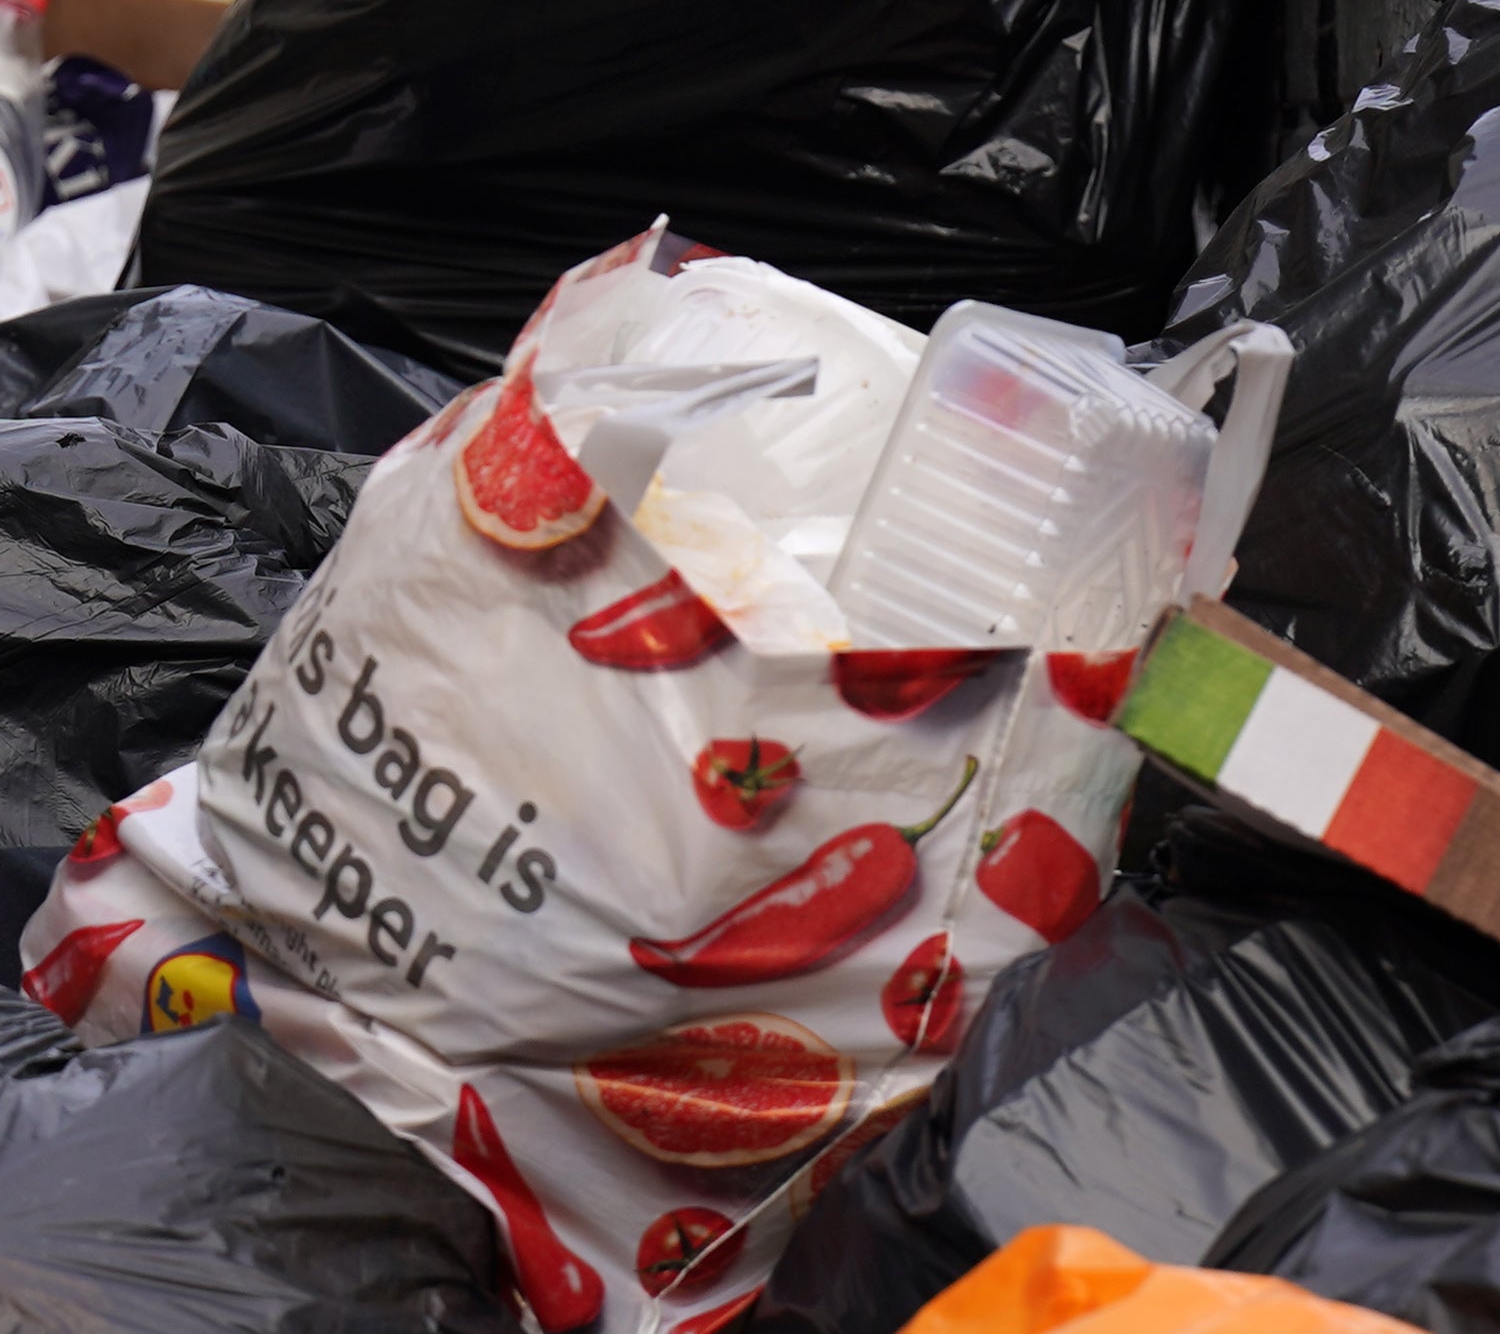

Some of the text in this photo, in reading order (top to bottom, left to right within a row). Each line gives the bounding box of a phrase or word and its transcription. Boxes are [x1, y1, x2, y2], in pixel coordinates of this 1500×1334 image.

[242, 701, 457, 989] keeper
[337, 655, 477, 857] bag
[477, 801, 557, 914] is
